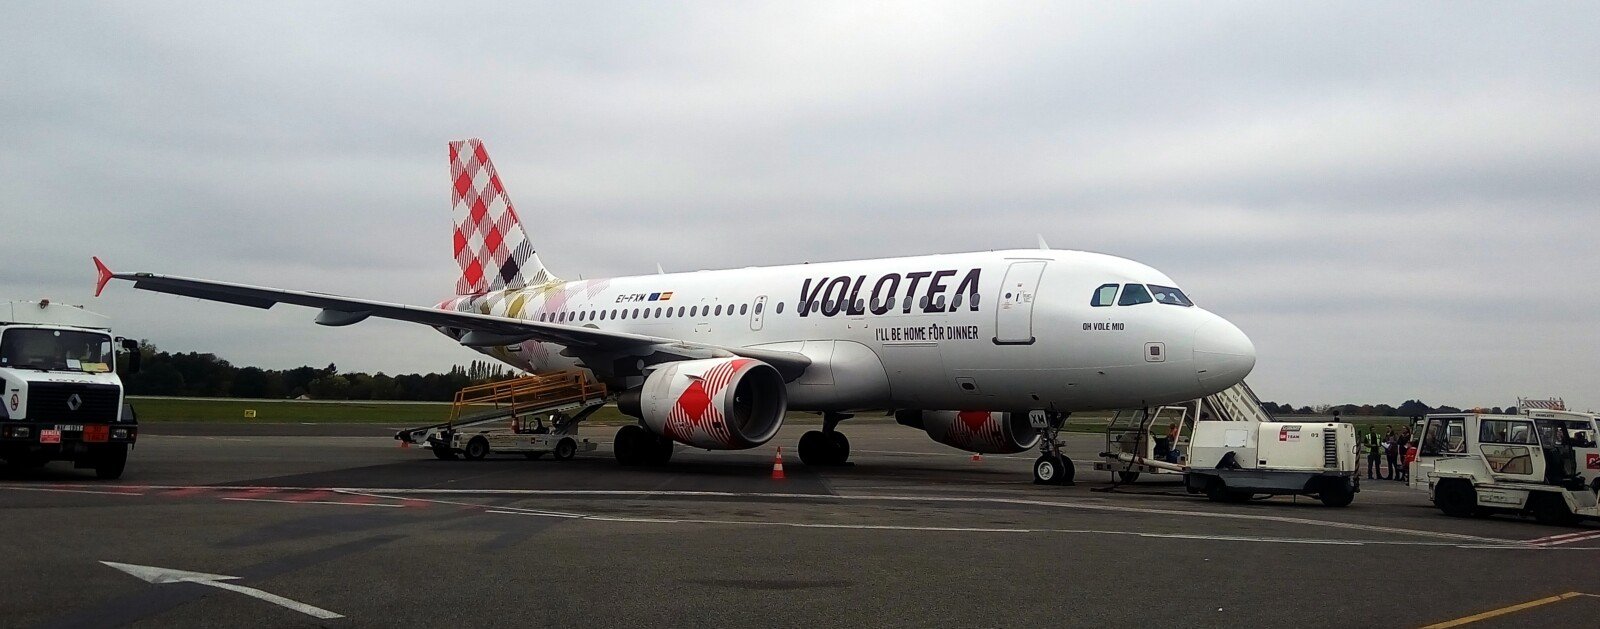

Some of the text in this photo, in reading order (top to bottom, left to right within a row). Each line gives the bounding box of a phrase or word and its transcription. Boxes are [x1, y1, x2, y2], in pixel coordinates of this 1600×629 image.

[799, 268, 981, 317] VOLOTEA
[615, 293, 647, 303] EI-FXM
[1082, 322, 1125, 331] OH VOLE MIO
[875, 325, 979, 341] I'LL BE HOME FOR DINNER
[1031, 414, 1045, 424] XM
